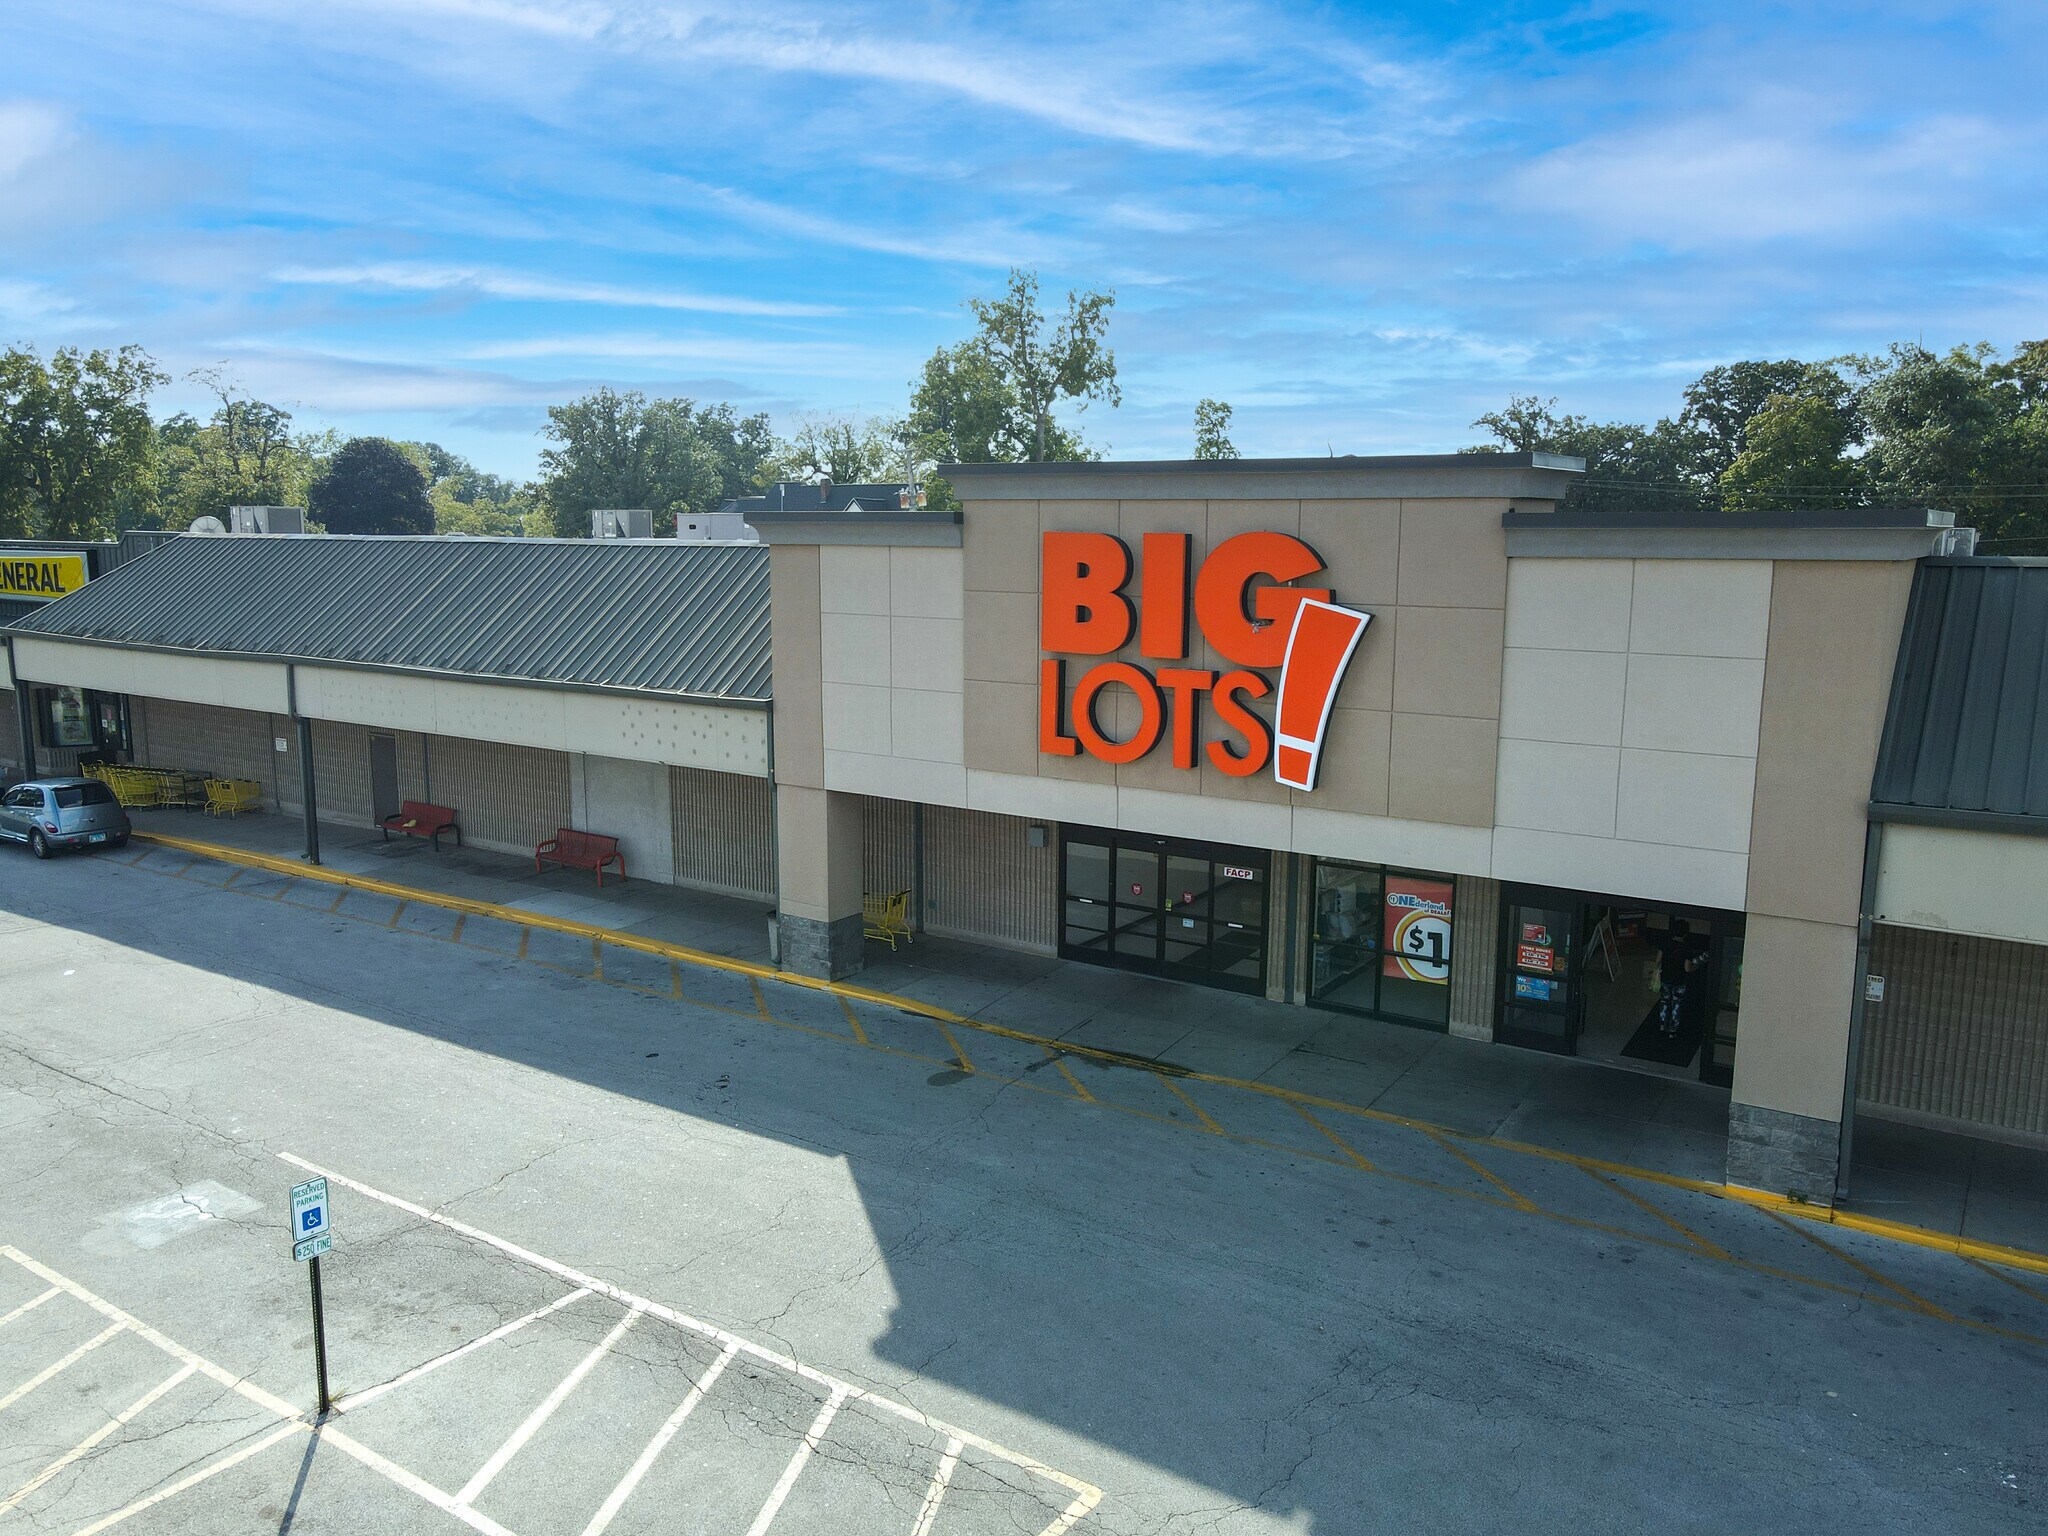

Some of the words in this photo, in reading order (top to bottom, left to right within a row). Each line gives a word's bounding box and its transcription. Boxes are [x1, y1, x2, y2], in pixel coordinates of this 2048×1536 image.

[0, 561, 65, 592] NERAL
[1042, 531, 1336, 669] BIG
[1226, 868, 1251, 878] FACP
[1409, 925, 1443, 968] $1
[293, 1182, 325, 1199] RESERVED
[296, 1192, 324, 1207] PARKING
[316, 1237, 331, 1251] FINE
